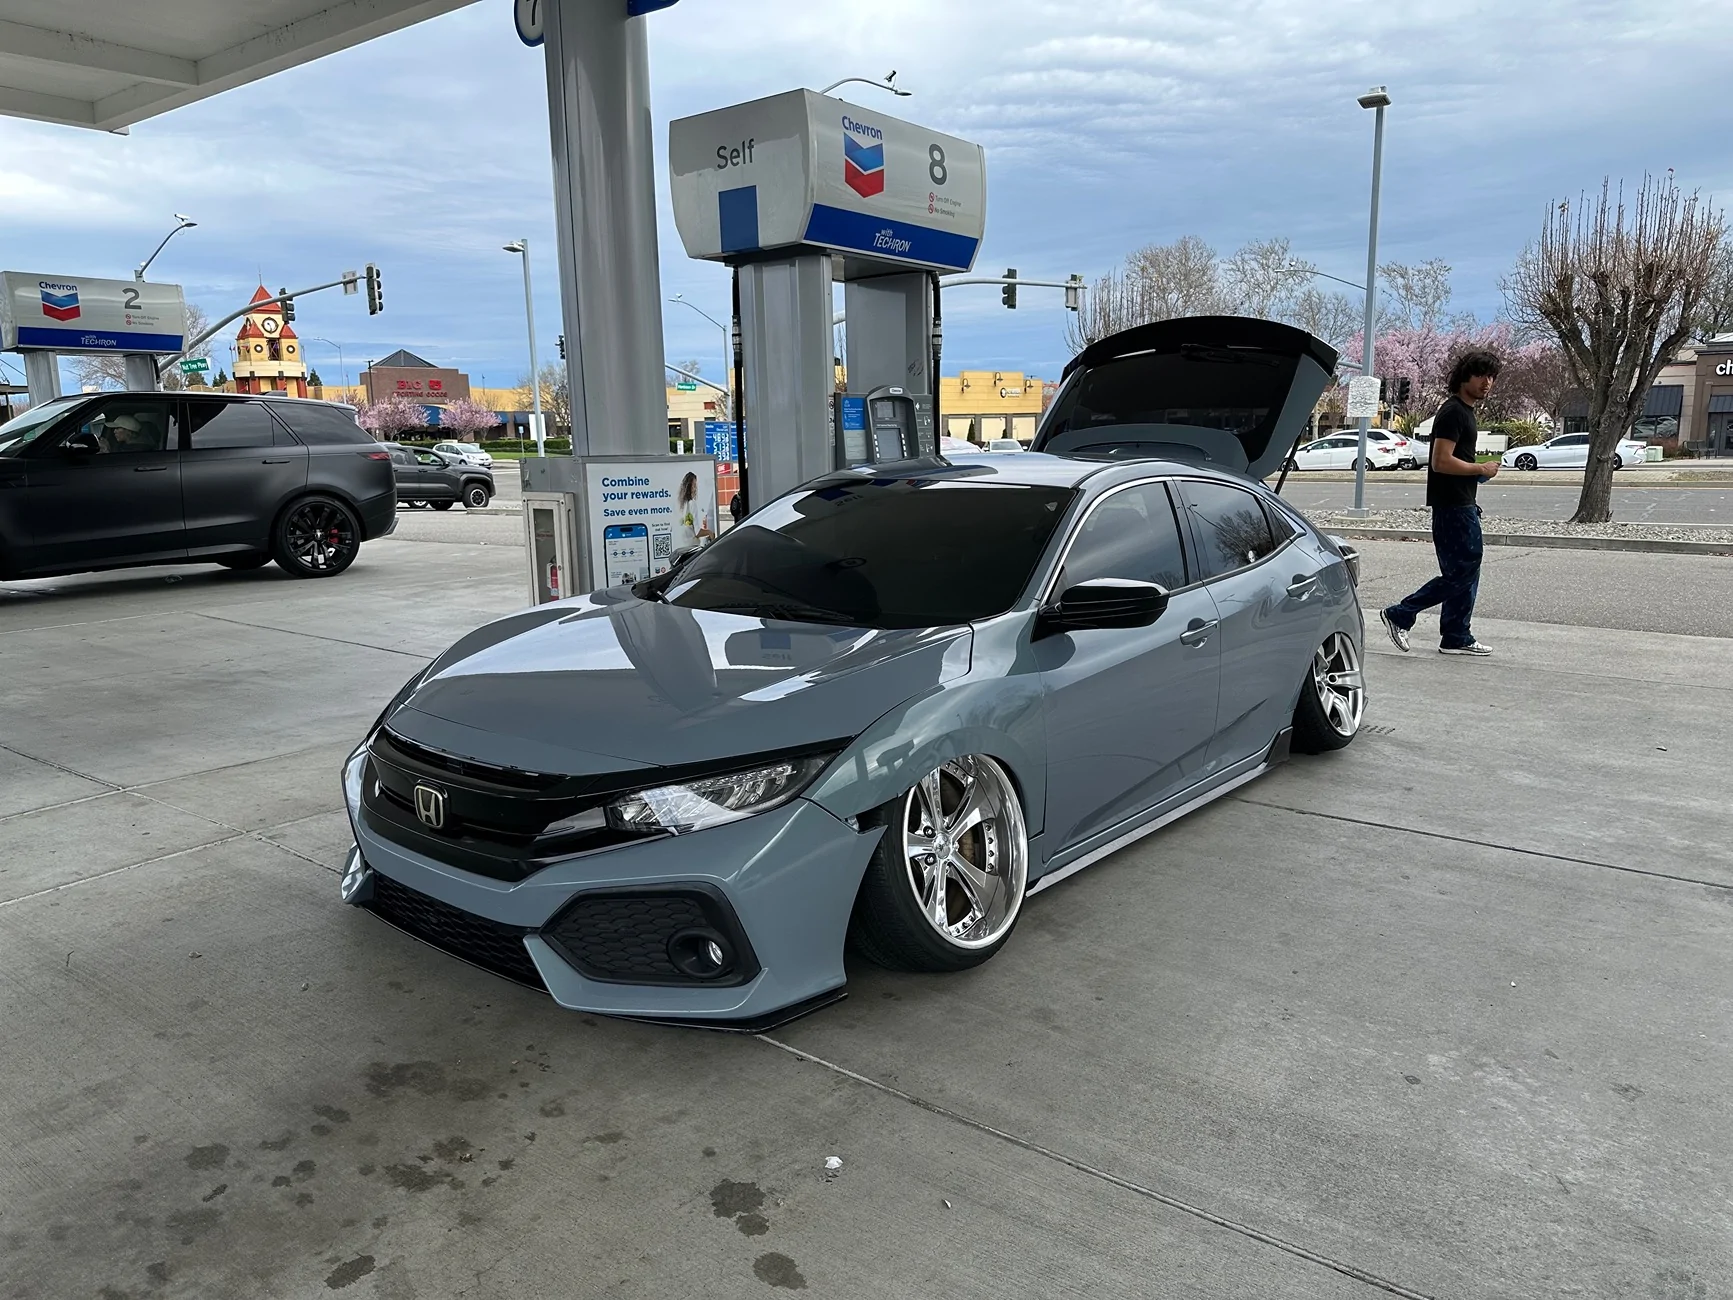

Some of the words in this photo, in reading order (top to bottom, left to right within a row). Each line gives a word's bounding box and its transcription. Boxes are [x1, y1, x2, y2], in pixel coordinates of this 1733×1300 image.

[841, 115, 883, 141] Chevron
[716, 138, 755, 170] Self
[928, 143, 948, 186] 8
[881, 228, 893, 237] with
[873, 233, 912, 253] TECHRON
[39, 281, 78, 292] Chevron
[122, 287, 142, 310] 2
[81, 337, 117, 347] TECHRON
[602, 476, 650, 487] Combine
[602, 491, 628, 502] your
[631, 488, 671, 500] rewards.
[603, 508, 626, 517] Save
[628, 507, 649, 516] even
[650, 506, 672, 515] more.
